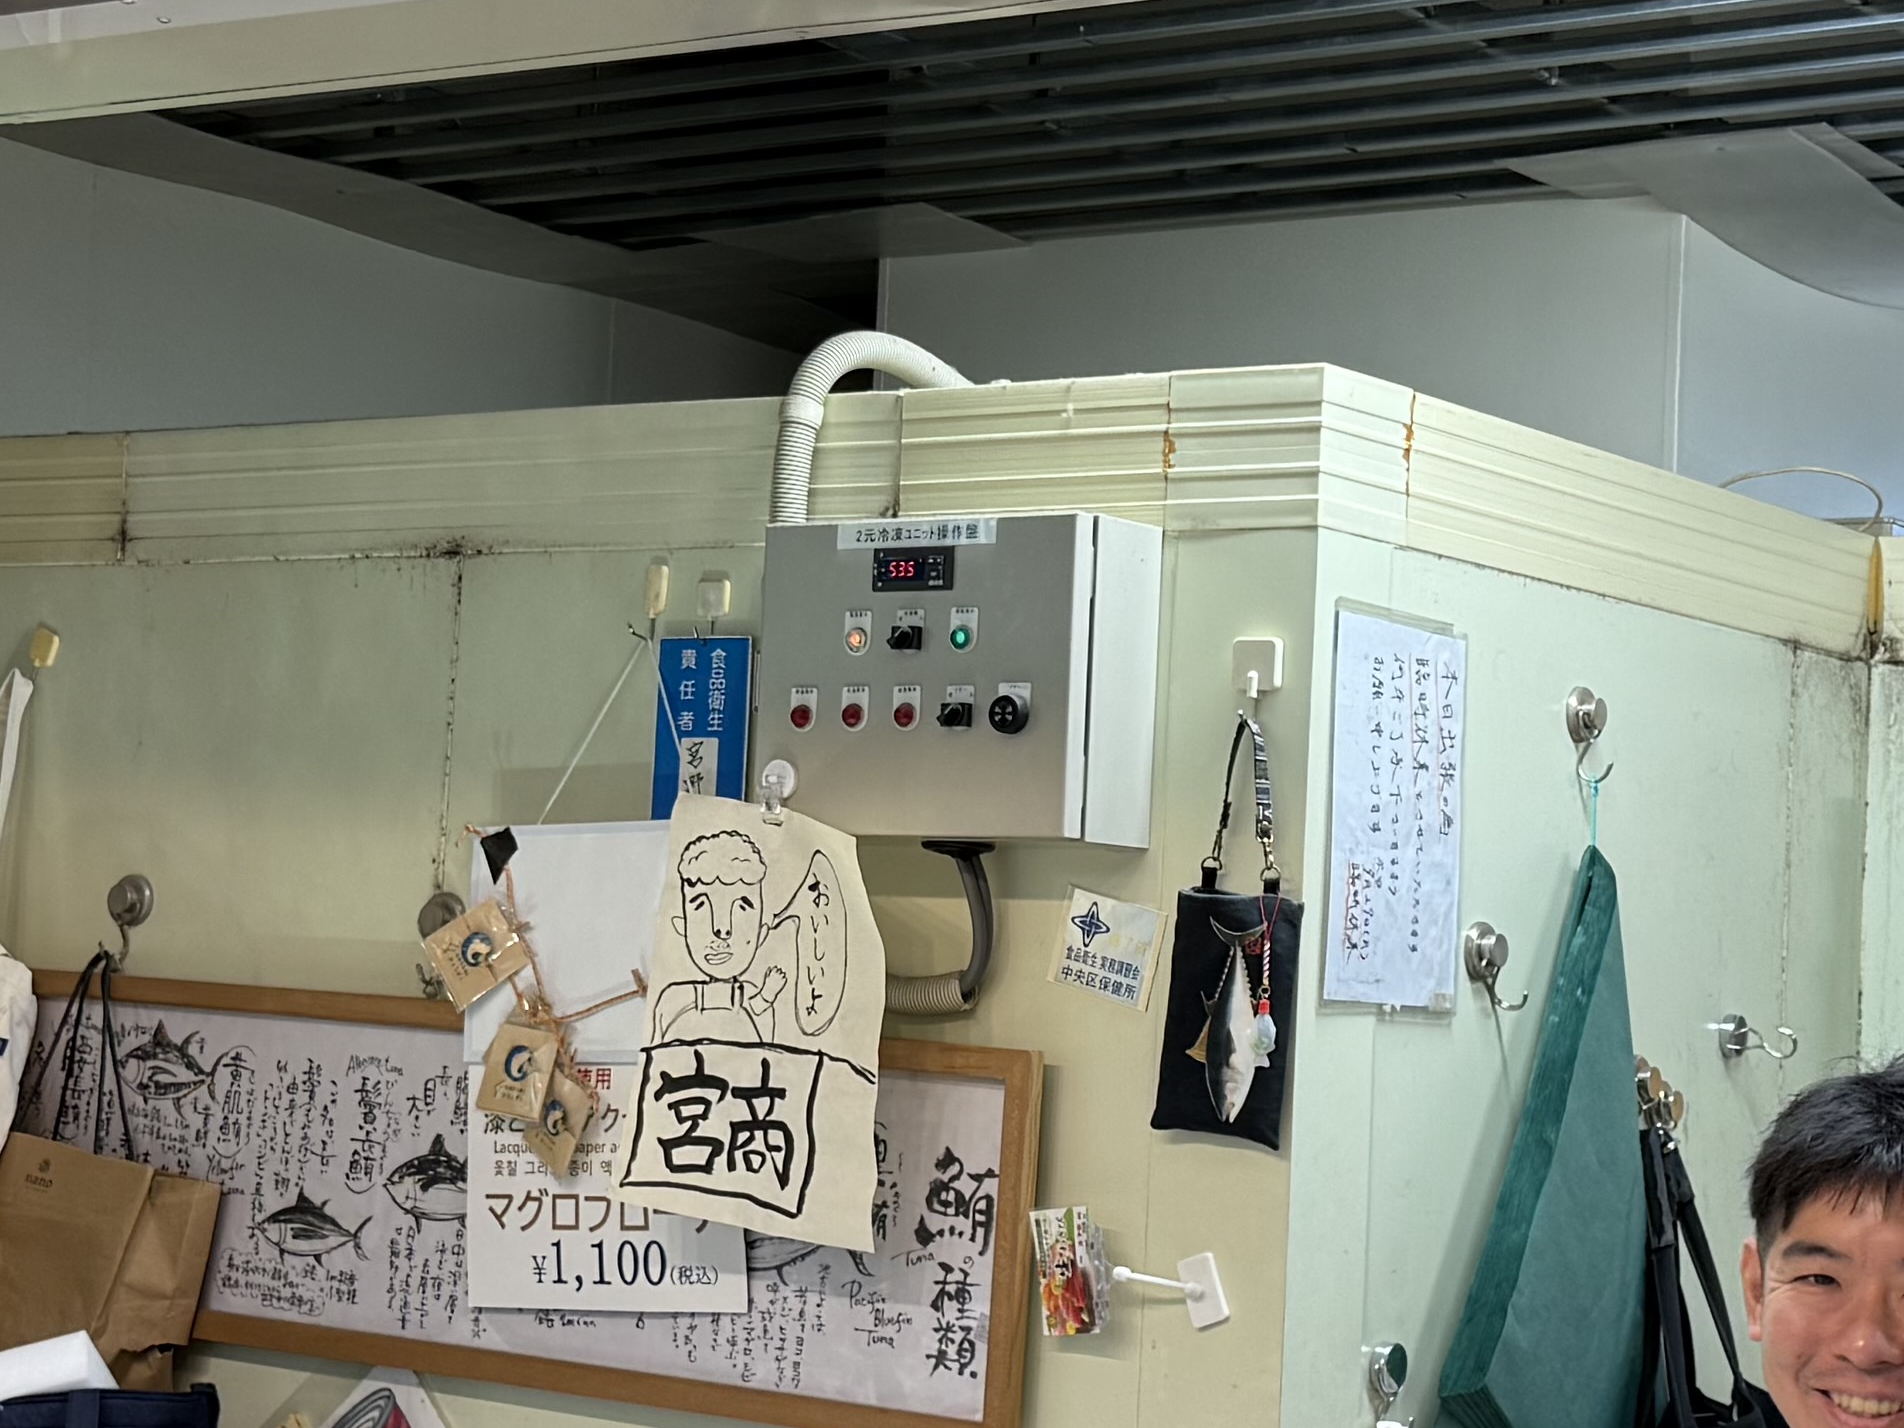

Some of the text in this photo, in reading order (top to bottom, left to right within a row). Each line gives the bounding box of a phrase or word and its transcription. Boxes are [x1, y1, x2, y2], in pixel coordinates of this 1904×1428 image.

[678, 649, 697, 731] 責任者
[707, 648, 727, 731] 食品衛生
[804, 875, 831, 1018] おいしいよ
[1061, 965, 1136, 1000] 中央区保健所
[1065, 945, 1099, 967] 食品衛生
[655, 1050, 796, 1192] 宮商
[532, 1239, 719, 1291] ¥1,100 (税込)
